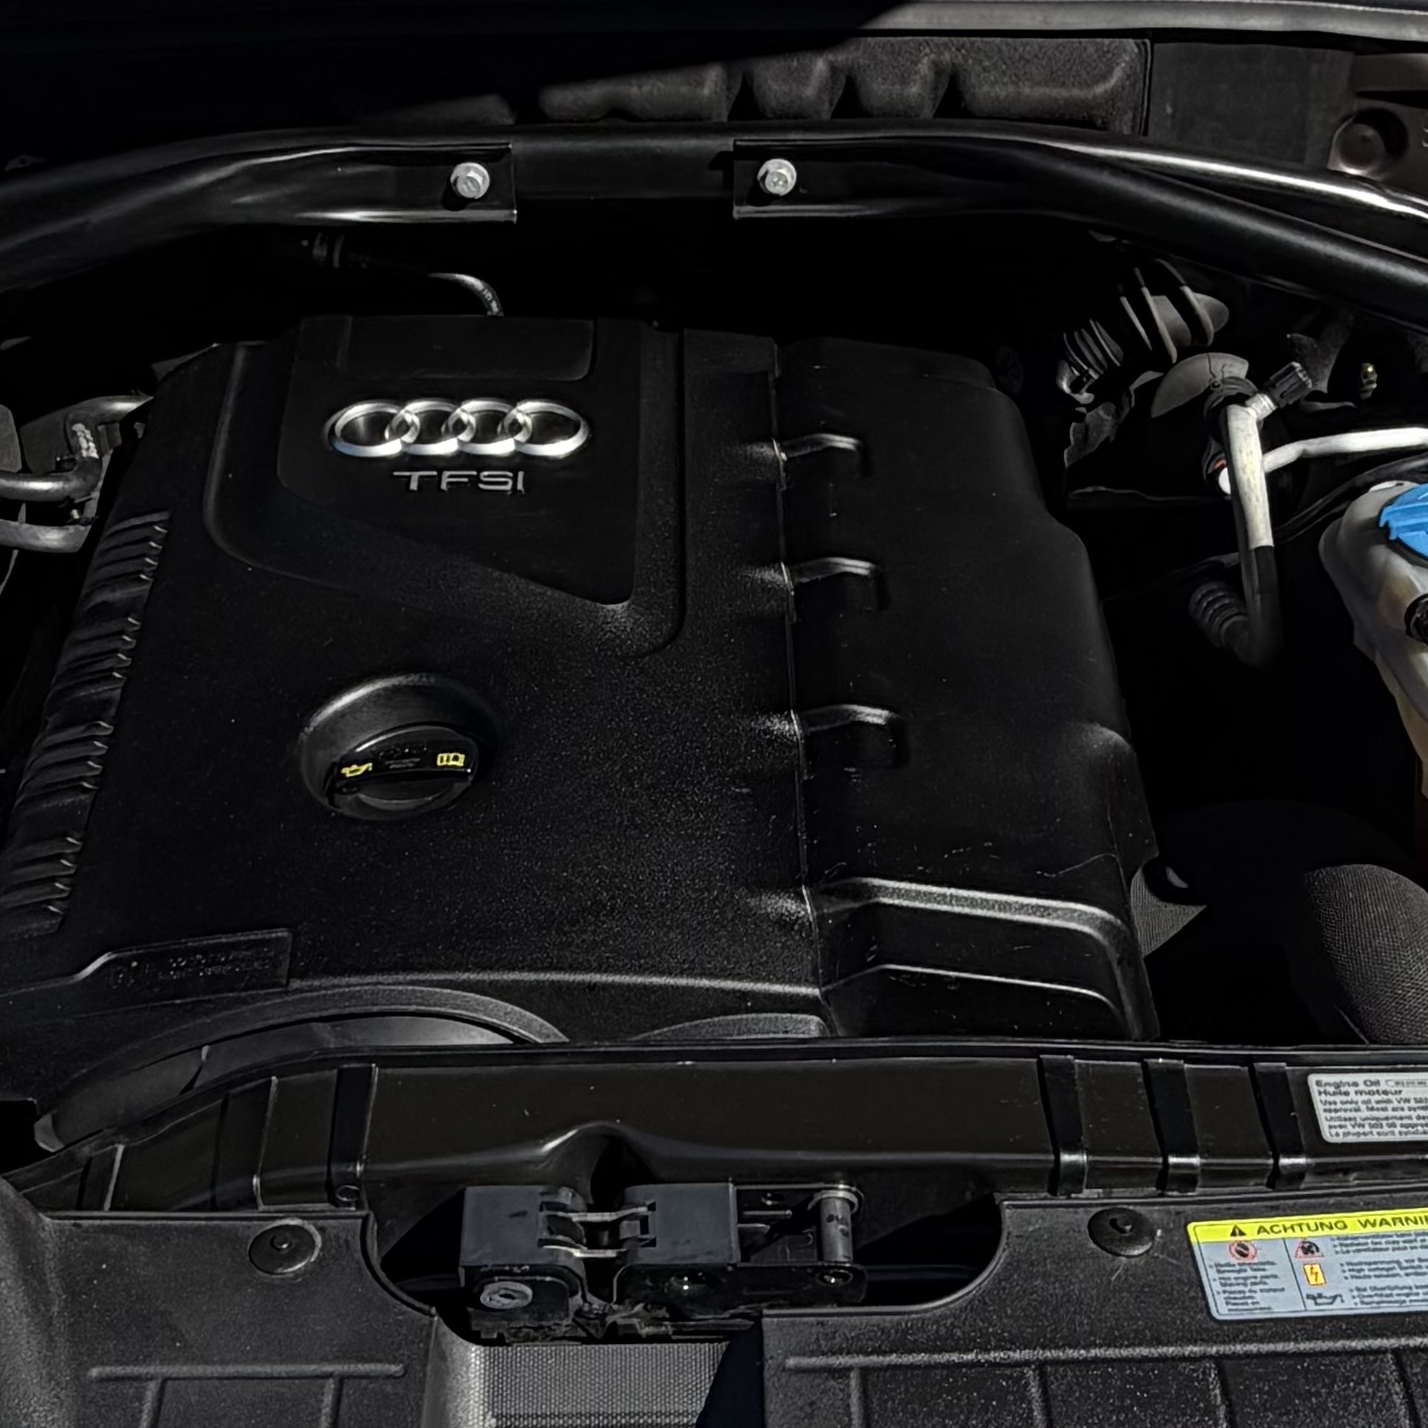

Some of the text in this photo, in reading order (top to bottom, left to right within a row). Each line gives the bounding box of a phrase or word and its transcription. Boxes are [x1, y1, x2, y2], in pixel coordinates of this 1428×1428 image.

[392, 470, 525, 494] TFSI
[1315, 1079, 1360, 1090] Engine
[1363, 1079, 1381, 1087] Oil
[1318, 1089, 1404, 1097] Huile moteur
[1256, 1219, 1349, 1236] ACHTUNG
